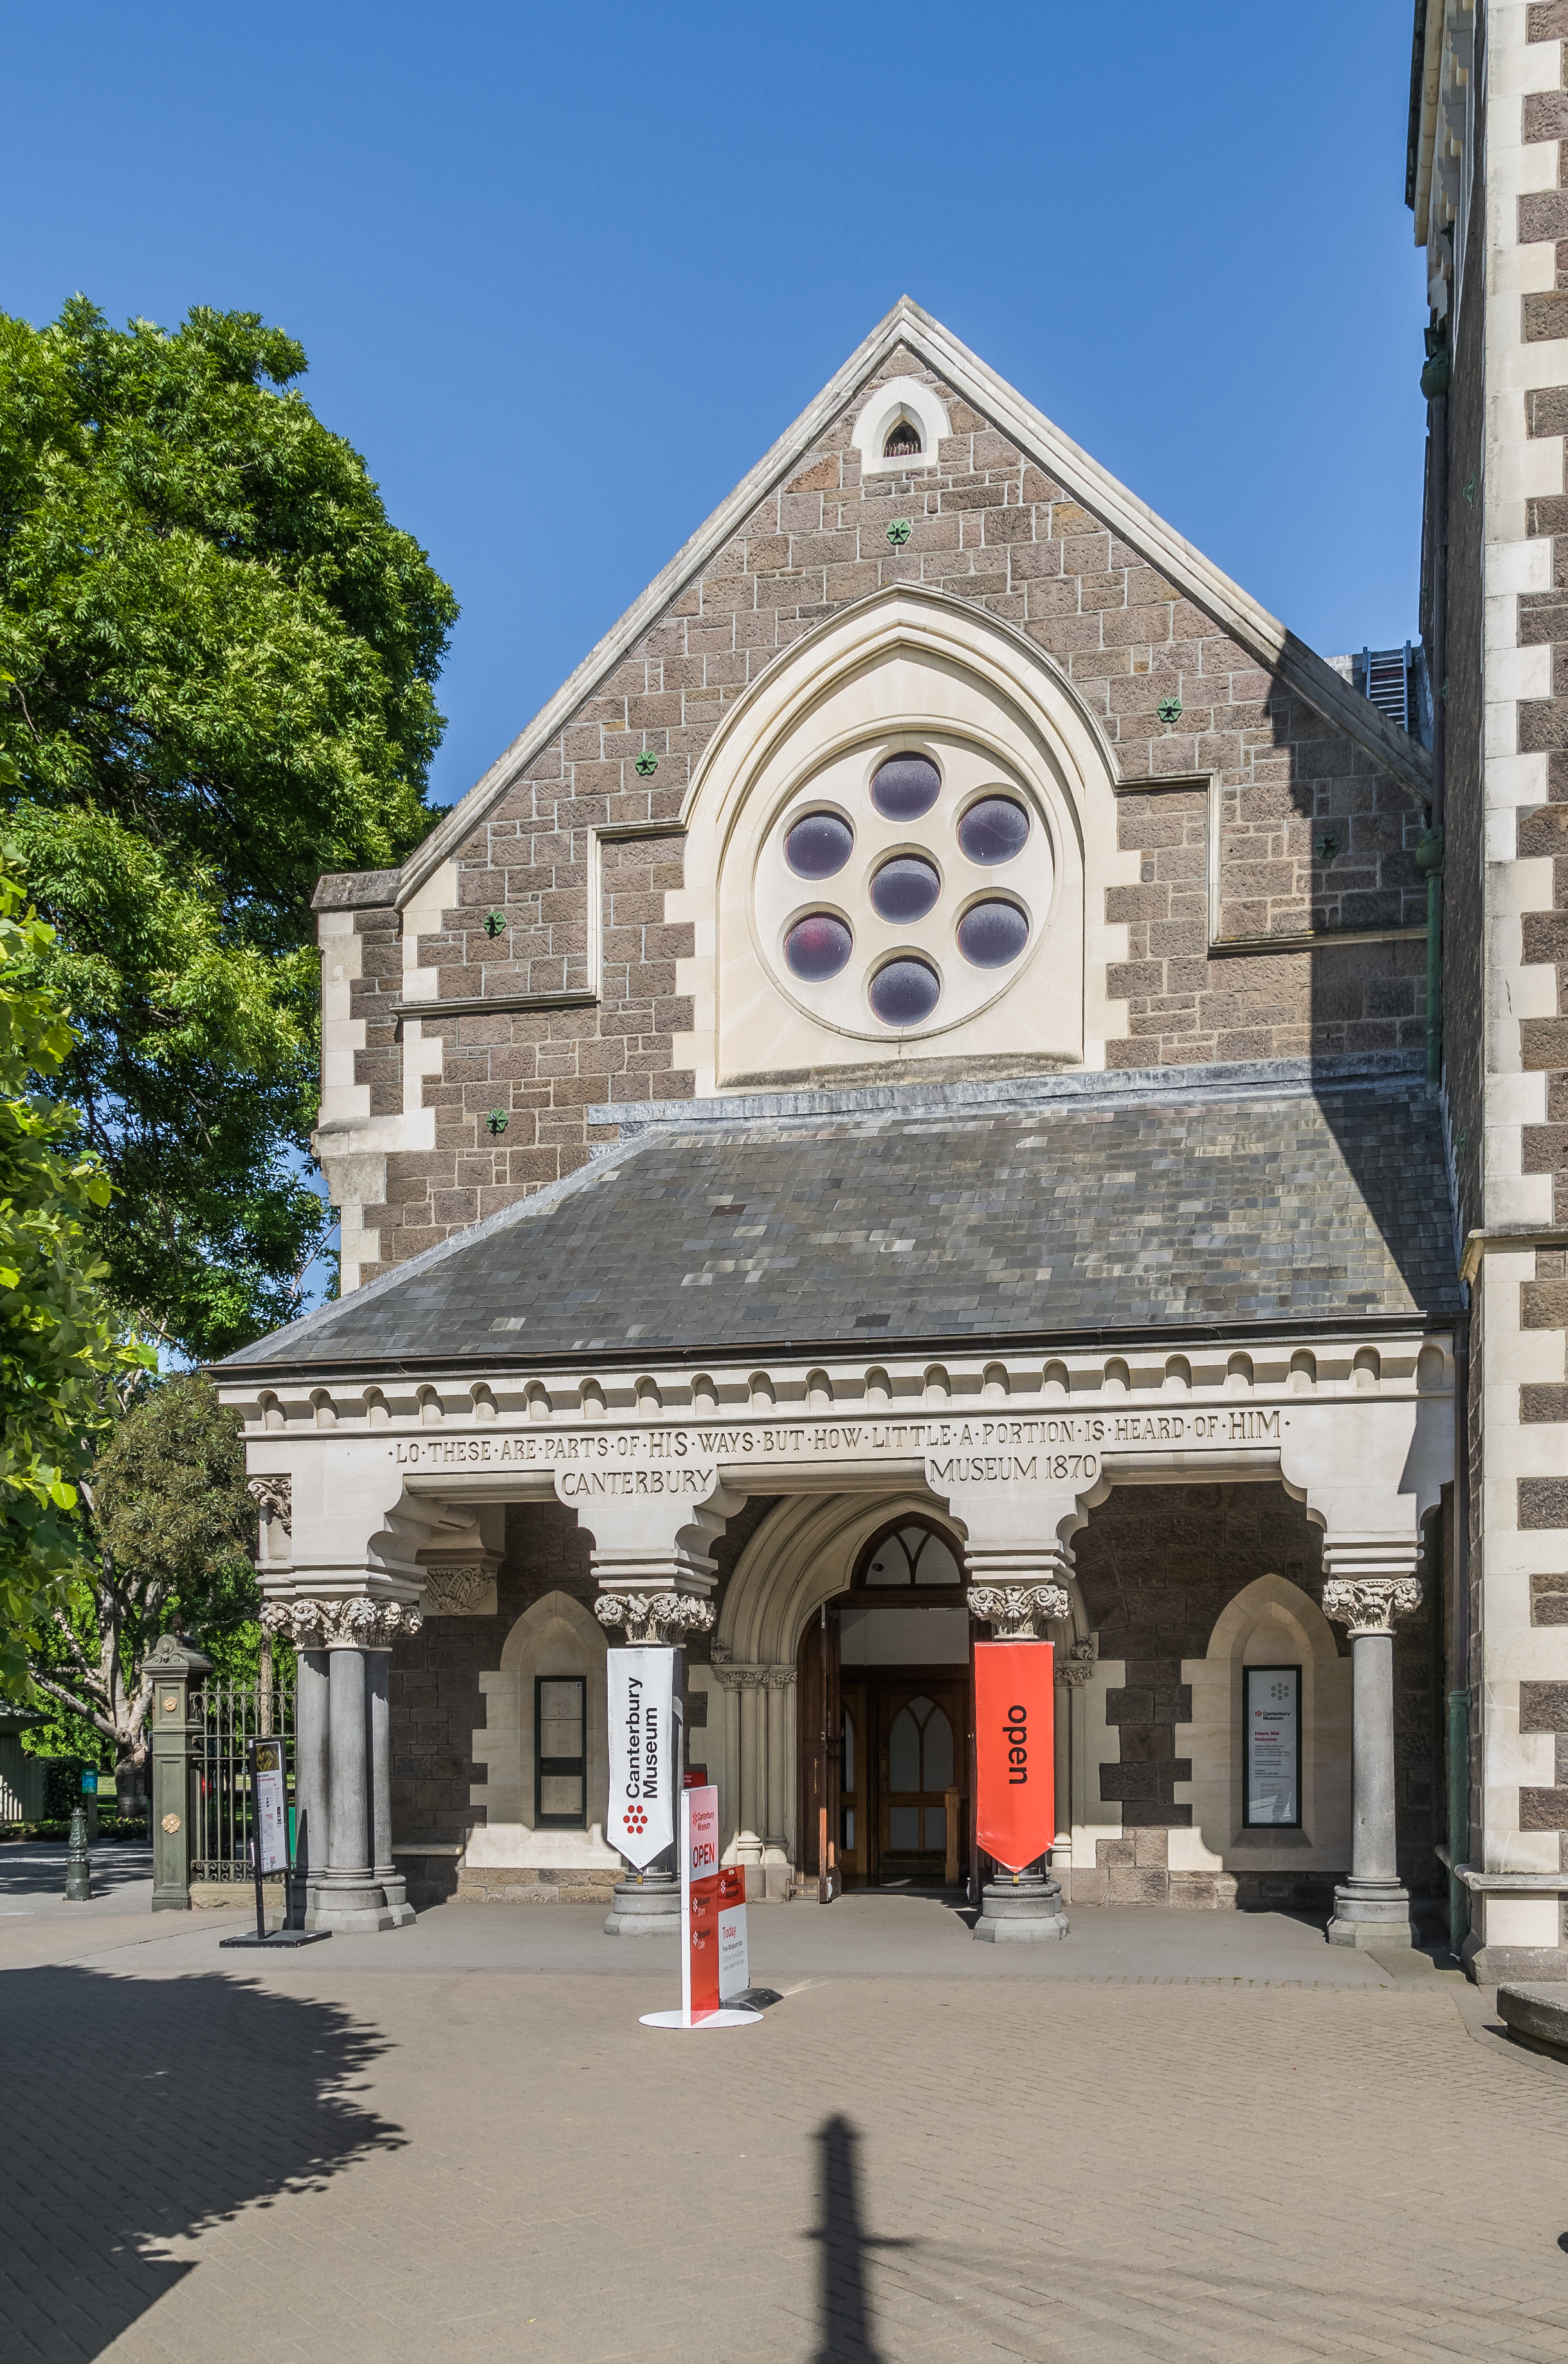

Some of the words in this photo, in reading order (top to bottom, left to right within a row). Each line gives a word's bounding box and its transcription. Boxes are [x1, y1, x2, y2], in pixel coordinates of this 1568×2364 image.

[396, 1443, 419, 1464] LO
[428, 1441, 491, 1462] THESE
[500, 1439, 536, 1460] ARE
[544, 1437, 608, 1459] PARTS
[617, 1436, 640, 1457] OF
[648, 1432, 688, 1459] HIS
[697, 1432, 754, 1453] WAYS
[763, 1430, 805, 1451] BUT
[814, 1427, 863, 1450] HOW
[872, 1424, 951, 1448] LITTLE
[959, 1424, 974, 1445] A
[982, 1420, 1075, 1445] PORTION
[1084, 1419, 1105, 1442] IS
[1115, 1416, 1184, 1441] HEARD
[1194, 1415, 1219, 1438] OF
[1228, 1410, 1281, 1439] HIM
[929, 1456, 1038, 1482] MUSEUM
[1045, 1454, 1097, 1479] 1870
[561, 1469, 714, 1496] CANTERBURY
[625, 1677, 643, 1799] Canterbury
[1002, 1705, 1028, 1785] open
[643, 1707, 658, 1799] Museum
[697, 1811, 715, 1821] Canterbury
[697, 1822, 711, 1832] Museum
[693, 1842, 715, 1868] OPEN
[697, 1907, 706, 1916] Store
[722, 1924, 736, 1940] Today
[728, 1942, 738, 1950] Museum
